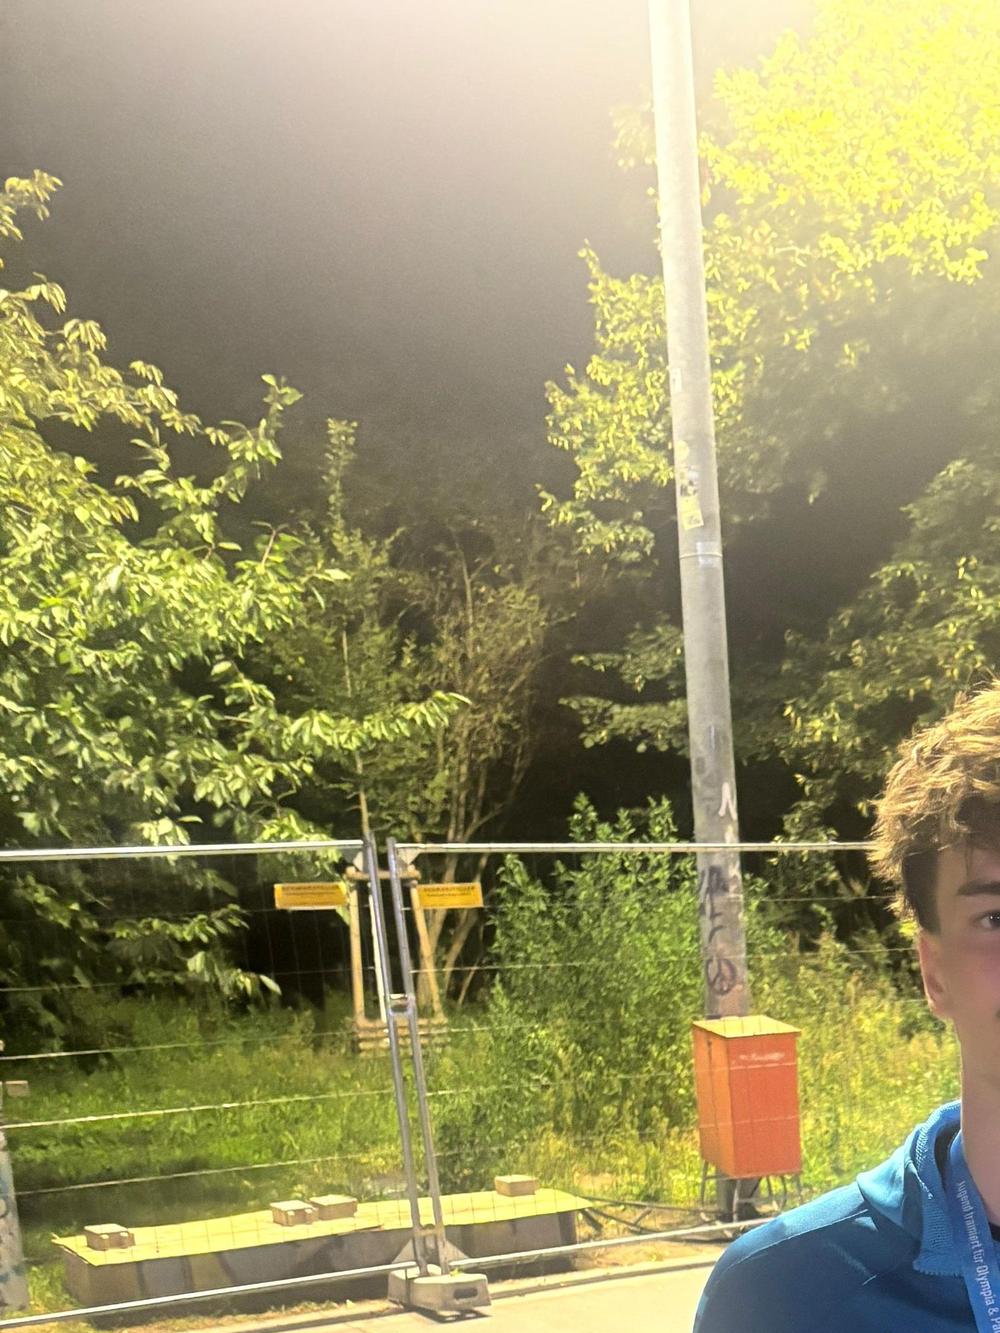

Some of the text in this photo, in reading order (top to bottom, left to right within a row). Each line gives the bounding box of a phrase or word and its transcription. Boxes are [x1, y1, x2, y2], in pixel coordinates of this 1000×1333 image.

[956, 1180, 974, 1212] Jugend
[963, 1211, 982, 1249] trainiert
[976, 1264, 997, 1306] Olympia
[988, 1306, 1000, 1317] &
